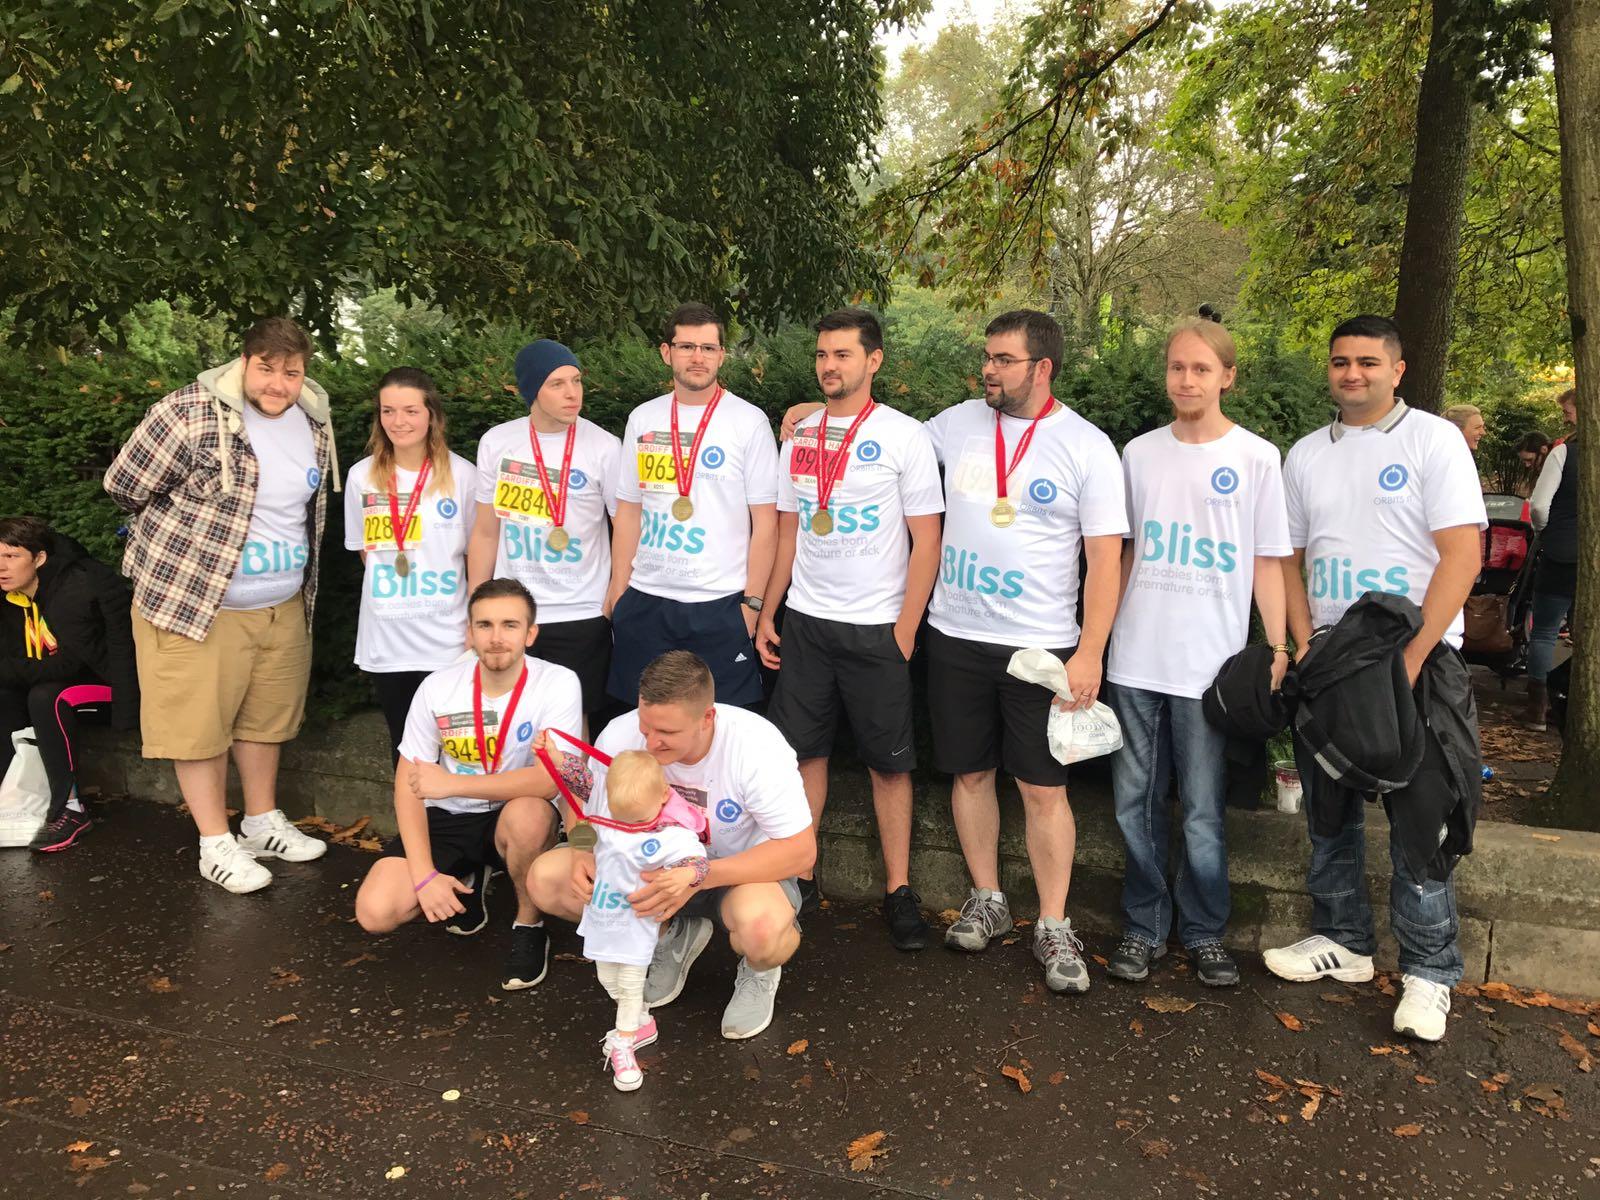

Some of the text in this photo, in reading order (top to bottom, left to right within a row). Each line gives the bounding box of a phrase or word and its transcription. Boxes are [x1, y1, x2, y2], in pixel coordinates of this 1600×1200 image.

[500, 473, 536, 493] CARDIFF
[1373, 496, 1403, 506] ORBITS
[365, 516, 418, 541] 2287
[505, 524, 583, 563] Bliss
[859, 544, 880, 556] sick
[1142, 520, 1238, 574] Bliss
[372, 562, 459, 598] Bliss
[943, 545, 1025, 599] Bliss
[1152, 565, 1192, 581] babies
[1195, 572, 1224, 586] born
[1312, 557, 1410, 600] Bliss
[1198, 587, 1211, 597] or
